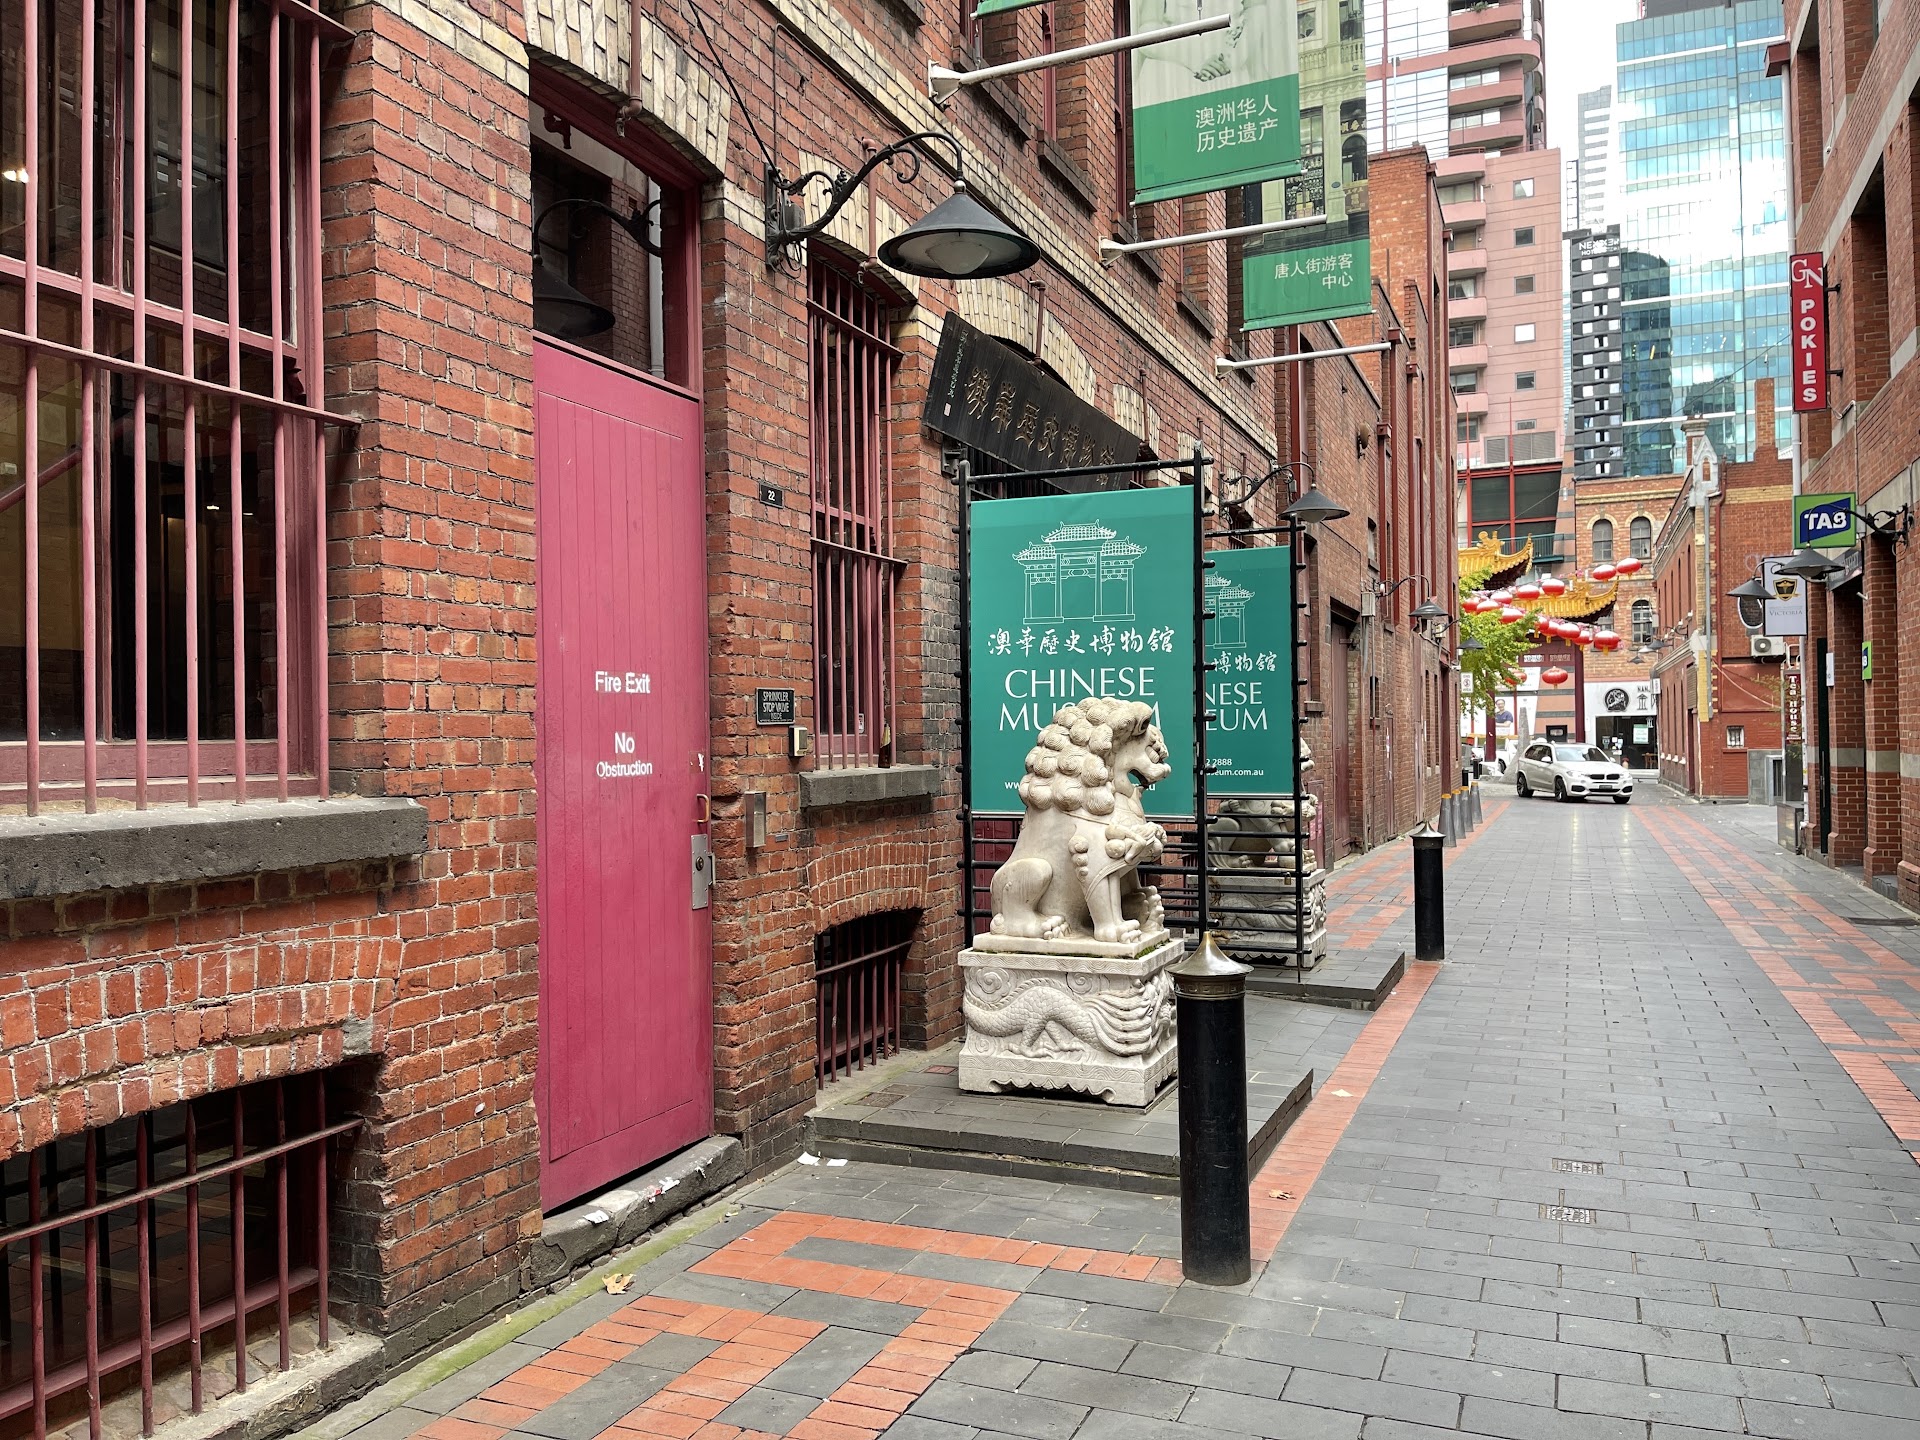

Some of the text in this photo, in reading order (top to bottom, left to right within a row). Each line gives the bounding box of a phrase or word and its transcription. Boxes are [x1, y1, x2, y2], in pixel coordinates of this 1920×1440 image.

[1195, 94, 1278, 129] 澳洲华人
[1196, 117, 1279, 153] 历史遗产
[1274, 253, 1353, 279] 唐人街游客
[1322, 271, 1354, 290] 中心
[1800, 299, 1817, 403] POKIES
[768, 490, 776, 502] 22
[1804, 511, 1847, 531] TAB
[987, 624, 1175, 658] 澳華歷史博物館
[1209, 650, 1278, 675] 博物館
[595, 670, 651, 693] Fire Exit
[1005, 666, 1155, 699] CHINESE
[1205, 681, 1263, 706] NESE
[762, 702, 775, 713] STOP
[1205, 707, 1268, 731] EUM
[615, 731, 636, 754] No
[596, 760, 653, 778] Obstruction
[1212, 758, 1233, 766] 2888
